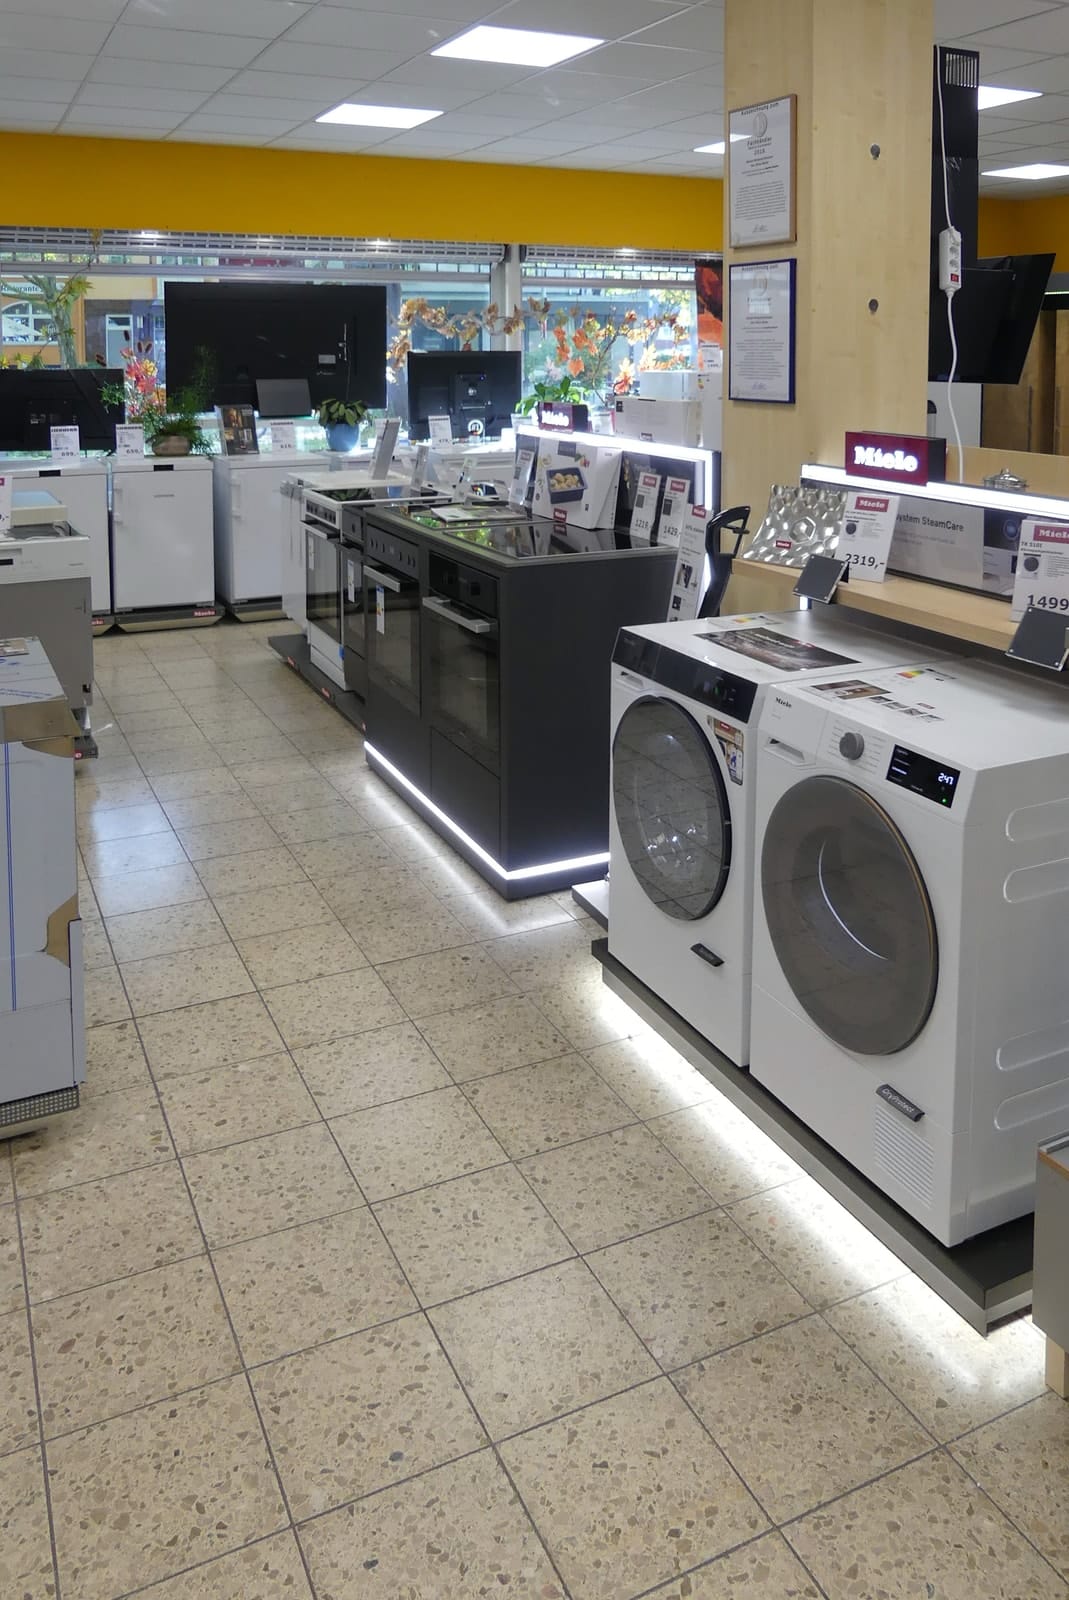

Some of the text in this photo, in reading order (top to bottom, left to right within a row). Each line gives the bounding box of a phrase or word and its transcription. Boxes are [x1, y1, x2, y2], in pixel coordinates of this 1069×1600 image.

[854, 446, 918, 472] Miele
[859, 500, 886, 509] Miele
[896, 513, 965, 533] ystem SteamCare
[845, 553, 886, 570] 2319,-
[776, 696, 792, 708] Miele
